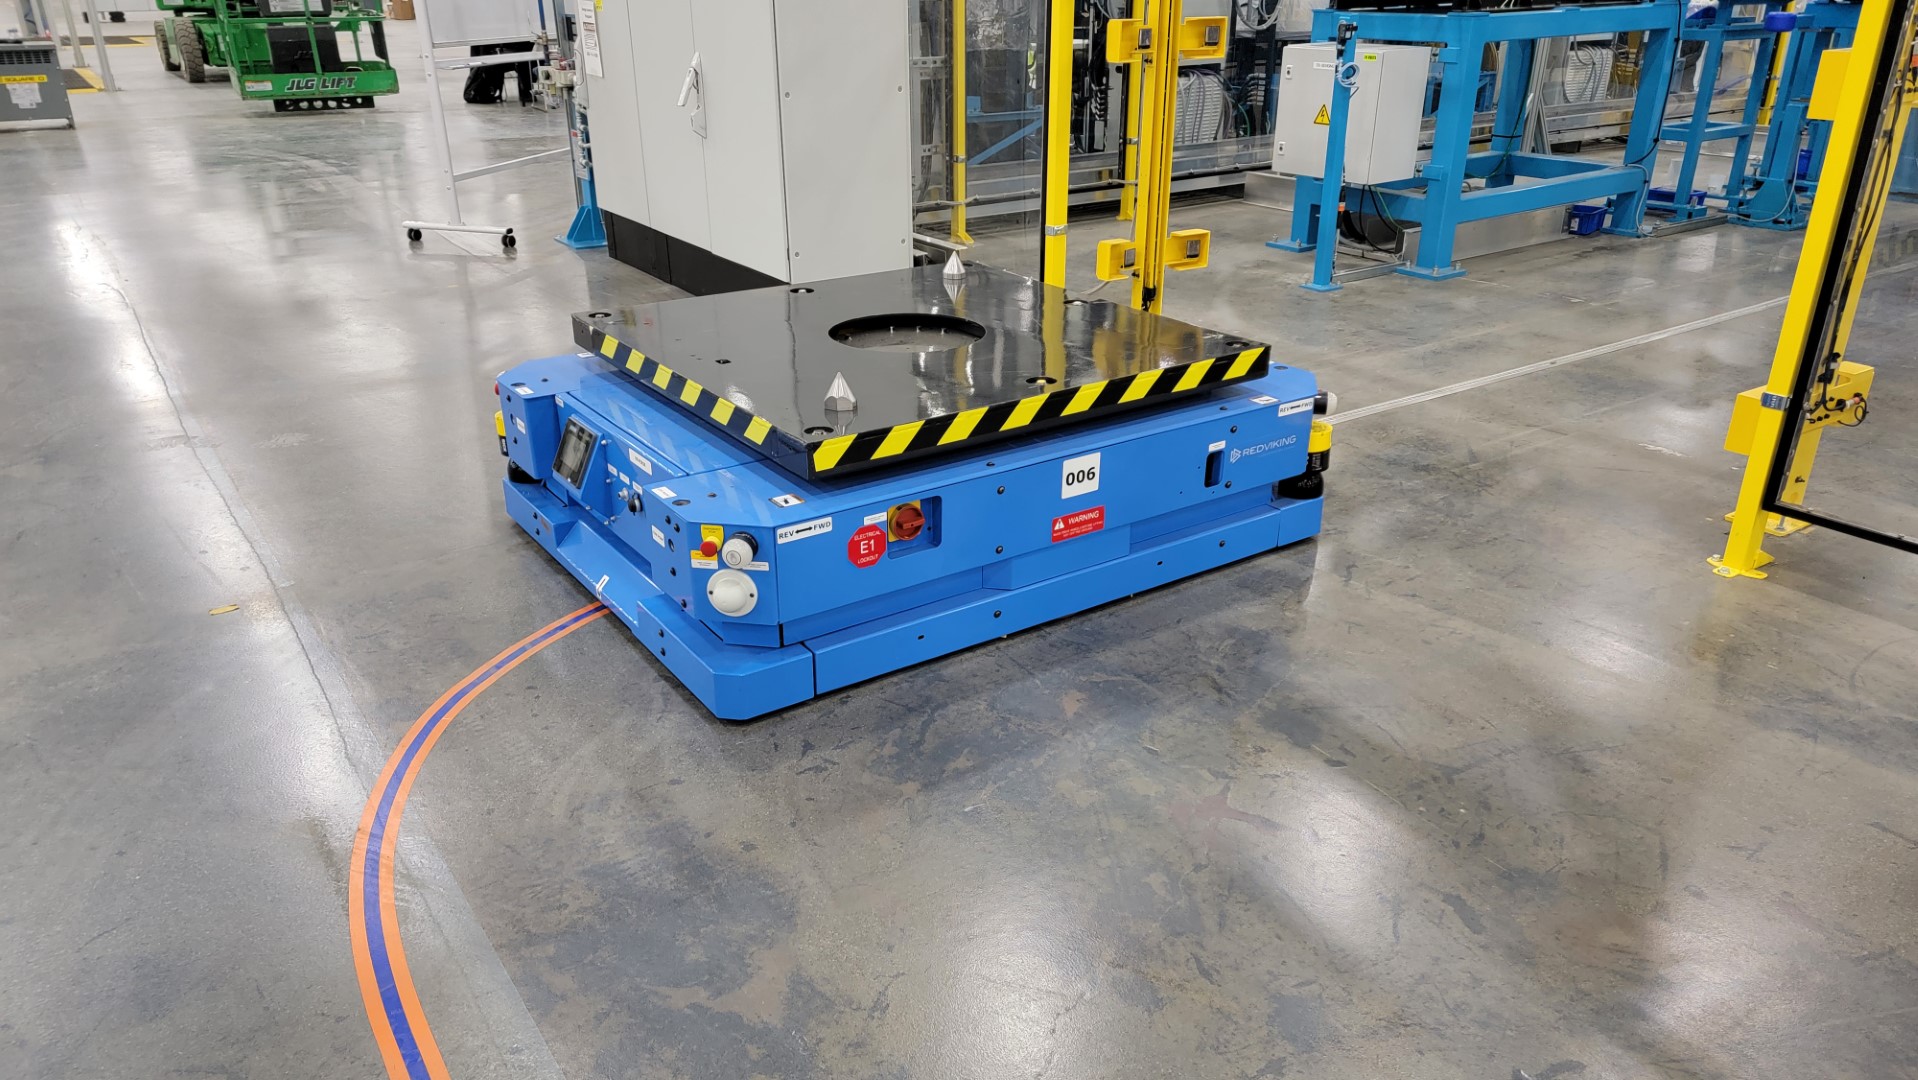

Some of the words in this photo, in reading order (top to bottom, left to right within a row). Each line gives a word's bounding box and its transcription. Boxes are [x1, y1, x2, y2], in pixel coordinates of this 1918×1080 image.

[285, 78, 317, 92] JLG
[319, 76, 357, 90] LIFT
[1242, 435, 1297, 457] REDVIKING
[1066, 466, 1096, 486] 006
[1068, 510, 1100, 525] WARNING
[778, 529, 795, 540] REV
[813, 521, 831, 531] FWD
[854, 530, 882, 541] ELECTRICAL
[860, 539, 875, 554] E1
[857, 554, 879, 565] LOCKOUT
